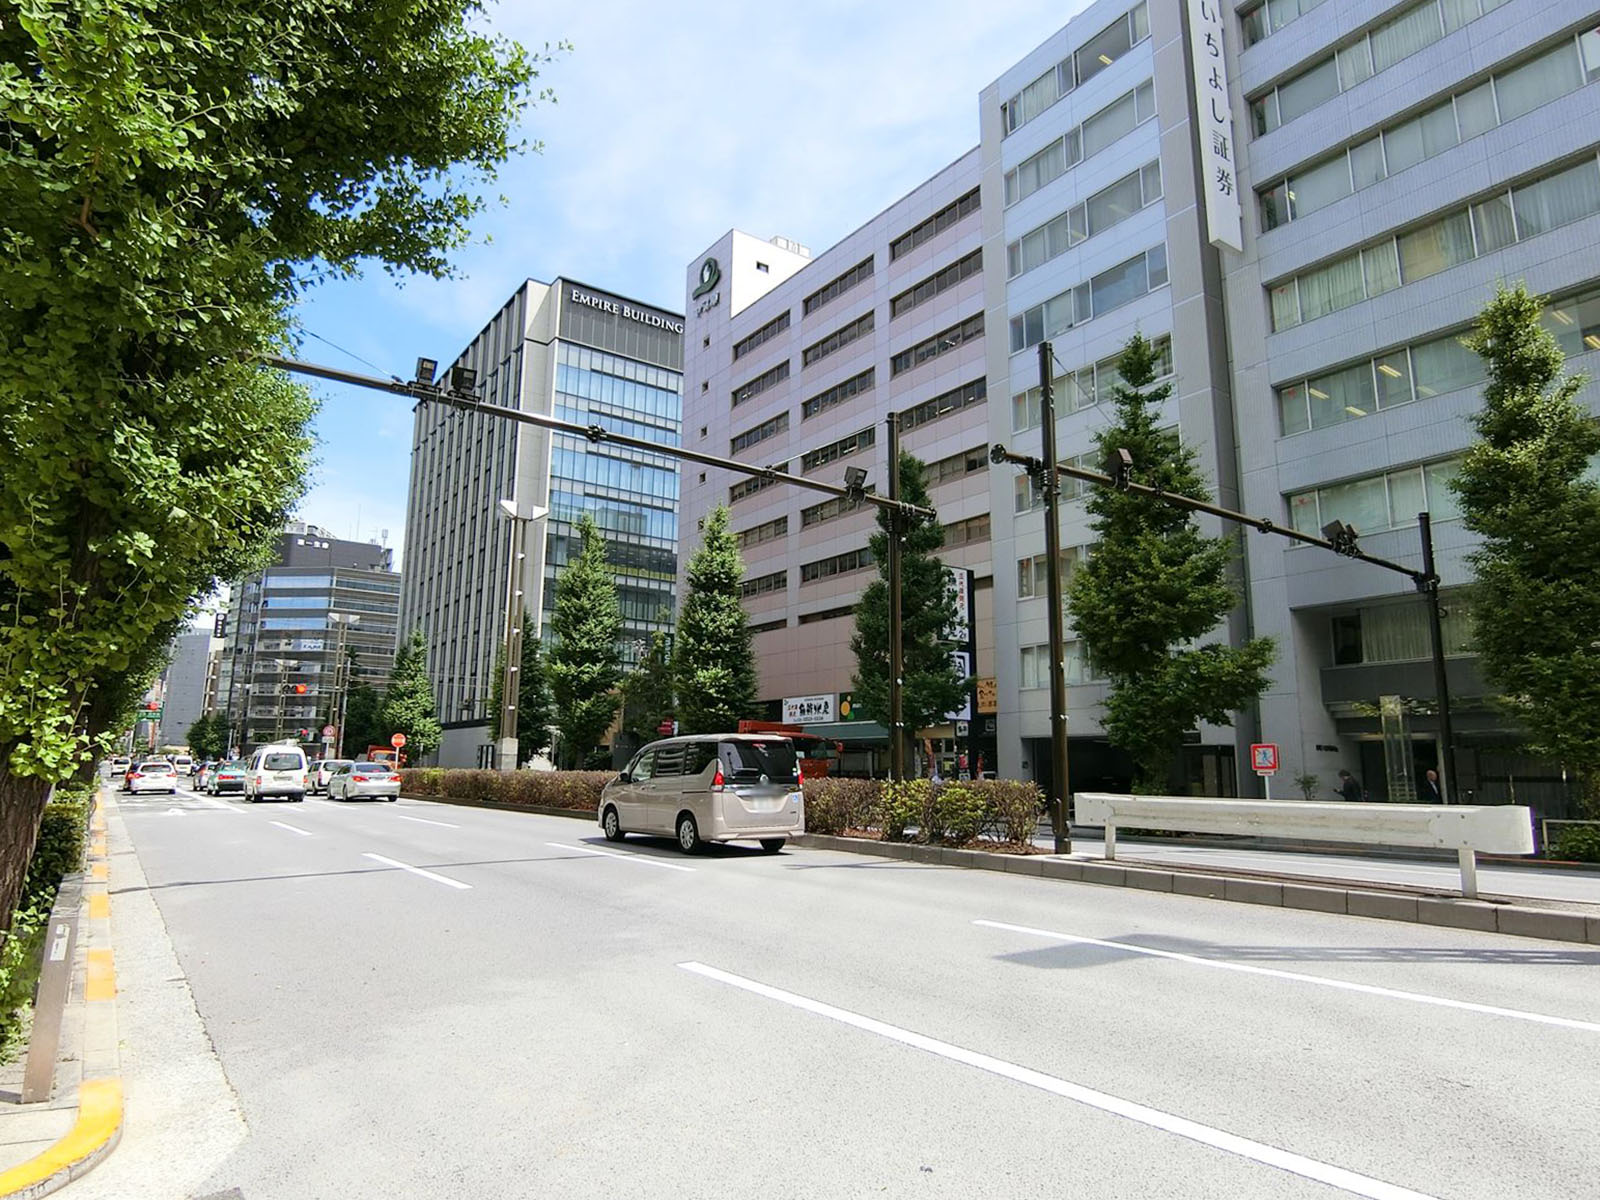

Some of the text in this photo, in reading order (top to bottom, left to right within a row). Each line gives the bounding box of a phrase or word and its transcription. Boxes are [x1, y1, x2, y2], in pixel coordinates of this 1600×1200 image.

[1202, 0, 1233, 196] いちよし証券
[571, 289, 684, 335] EMPIRE BUILDING
